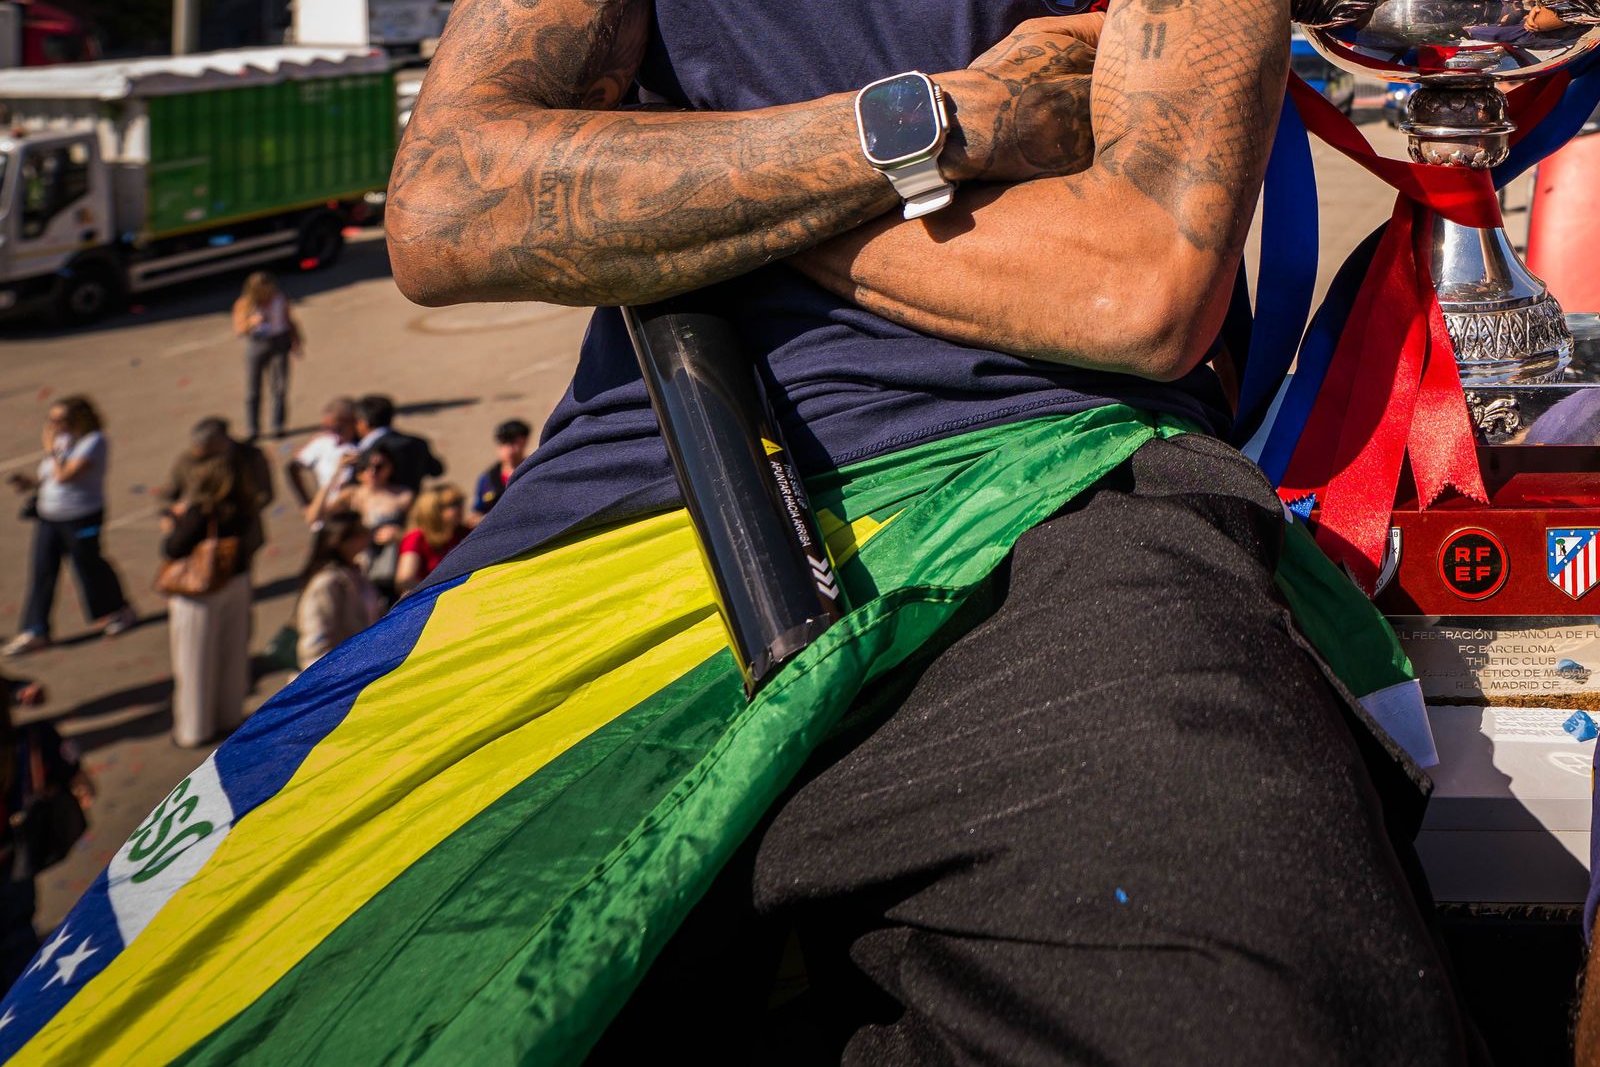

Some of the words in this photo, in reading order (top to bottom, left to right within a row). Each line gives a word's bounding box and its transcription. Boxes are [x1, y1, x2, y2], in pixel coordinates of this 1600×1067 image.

[770, 461, 792, 495] APUNTAR
[784, 495, 801, 519] HACIA
[793, 519, 812, 547] ARRIBA
[1455, 547, 1492, 562] RF
[1455, 566, 1492, 581] EF
[1497, 629, 1563, 639] ESPAÑOLA
[1565, 630, 1582, 639] DE
[1458, 645, 1476, 654] FC
[1478, 644, 1556, 654] BARCELONA
[1522, 657, 1557, 666] CLUB
[1523, 669, 1541, 678] DE
[1455, 681, 1488, 690] REAL
[1490, 681, 1539, 690] MADRID
[1542, 681, 1560, 690] CF
